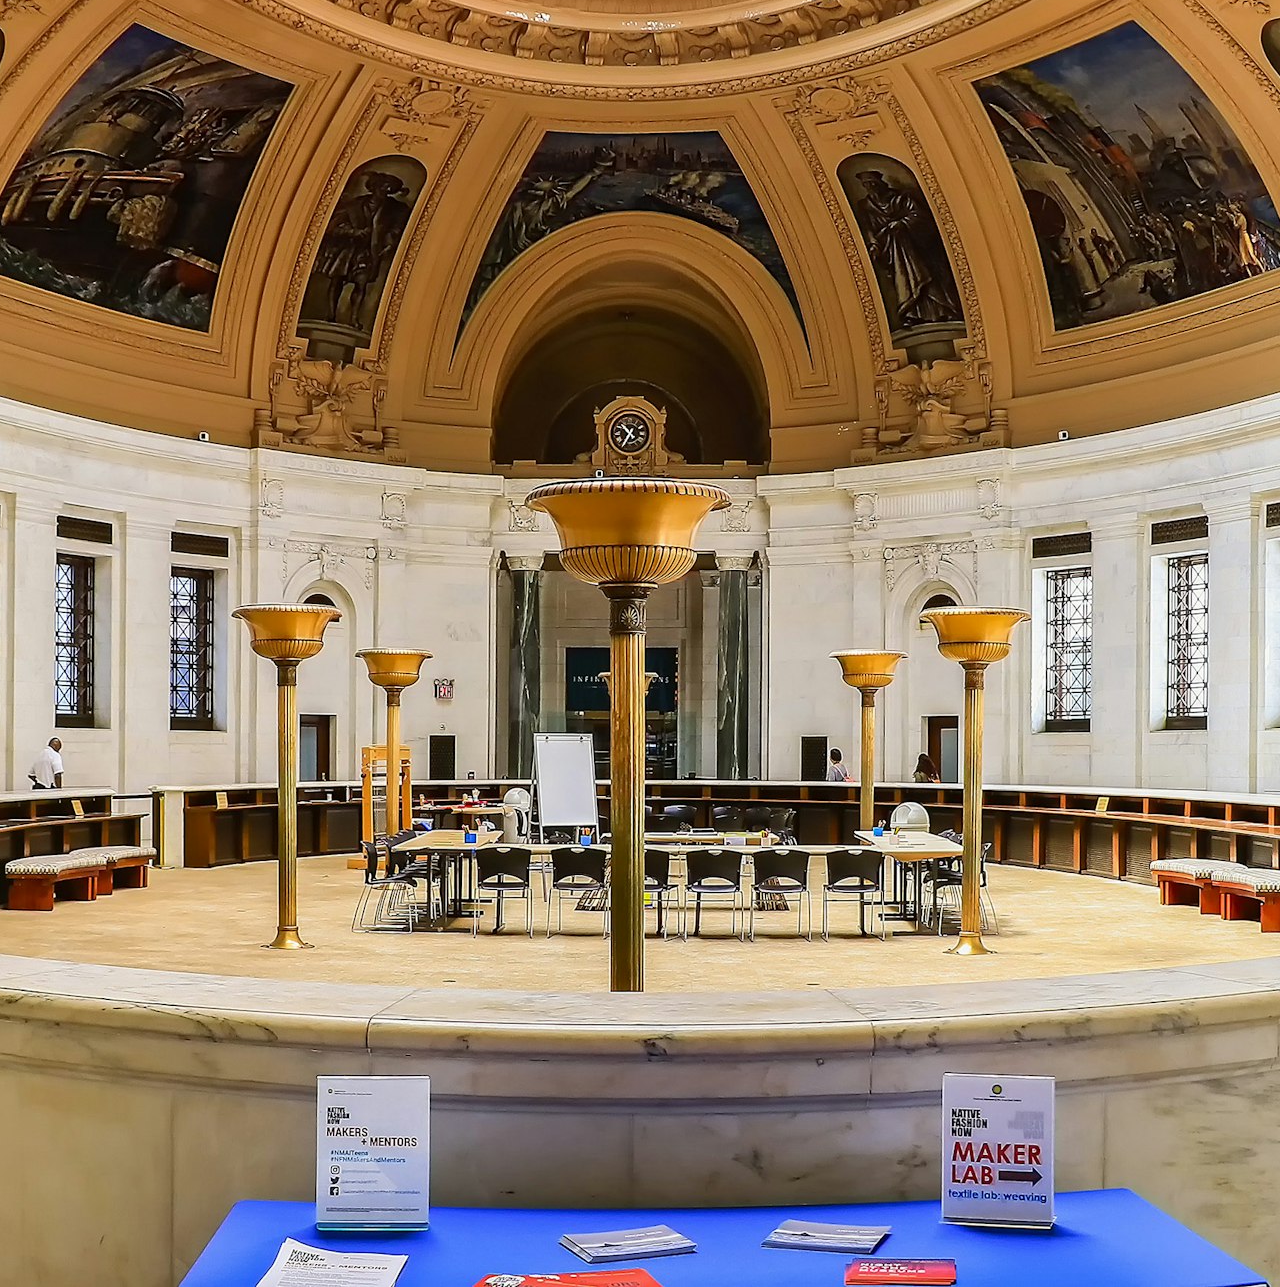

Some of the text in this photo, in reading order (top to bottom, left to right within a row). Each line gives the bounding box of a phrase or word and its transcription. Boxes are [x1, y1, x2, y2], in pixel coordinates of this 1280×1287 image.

[951, 1108, 981, 1119] NATIVE
[951, 1118, 988, 1129] FASHION
[326, 1127, 368, 1137] MAKERS
[951, 1127, 972, 1137] NOW
[369, 1137, 417, 1147] MENTORS
[952, 1141, 1042, 1165] MAKER
[951, 1164, 994, 1185] LAB
[948, 1189, 1047, 1204] textile lab: weaving
